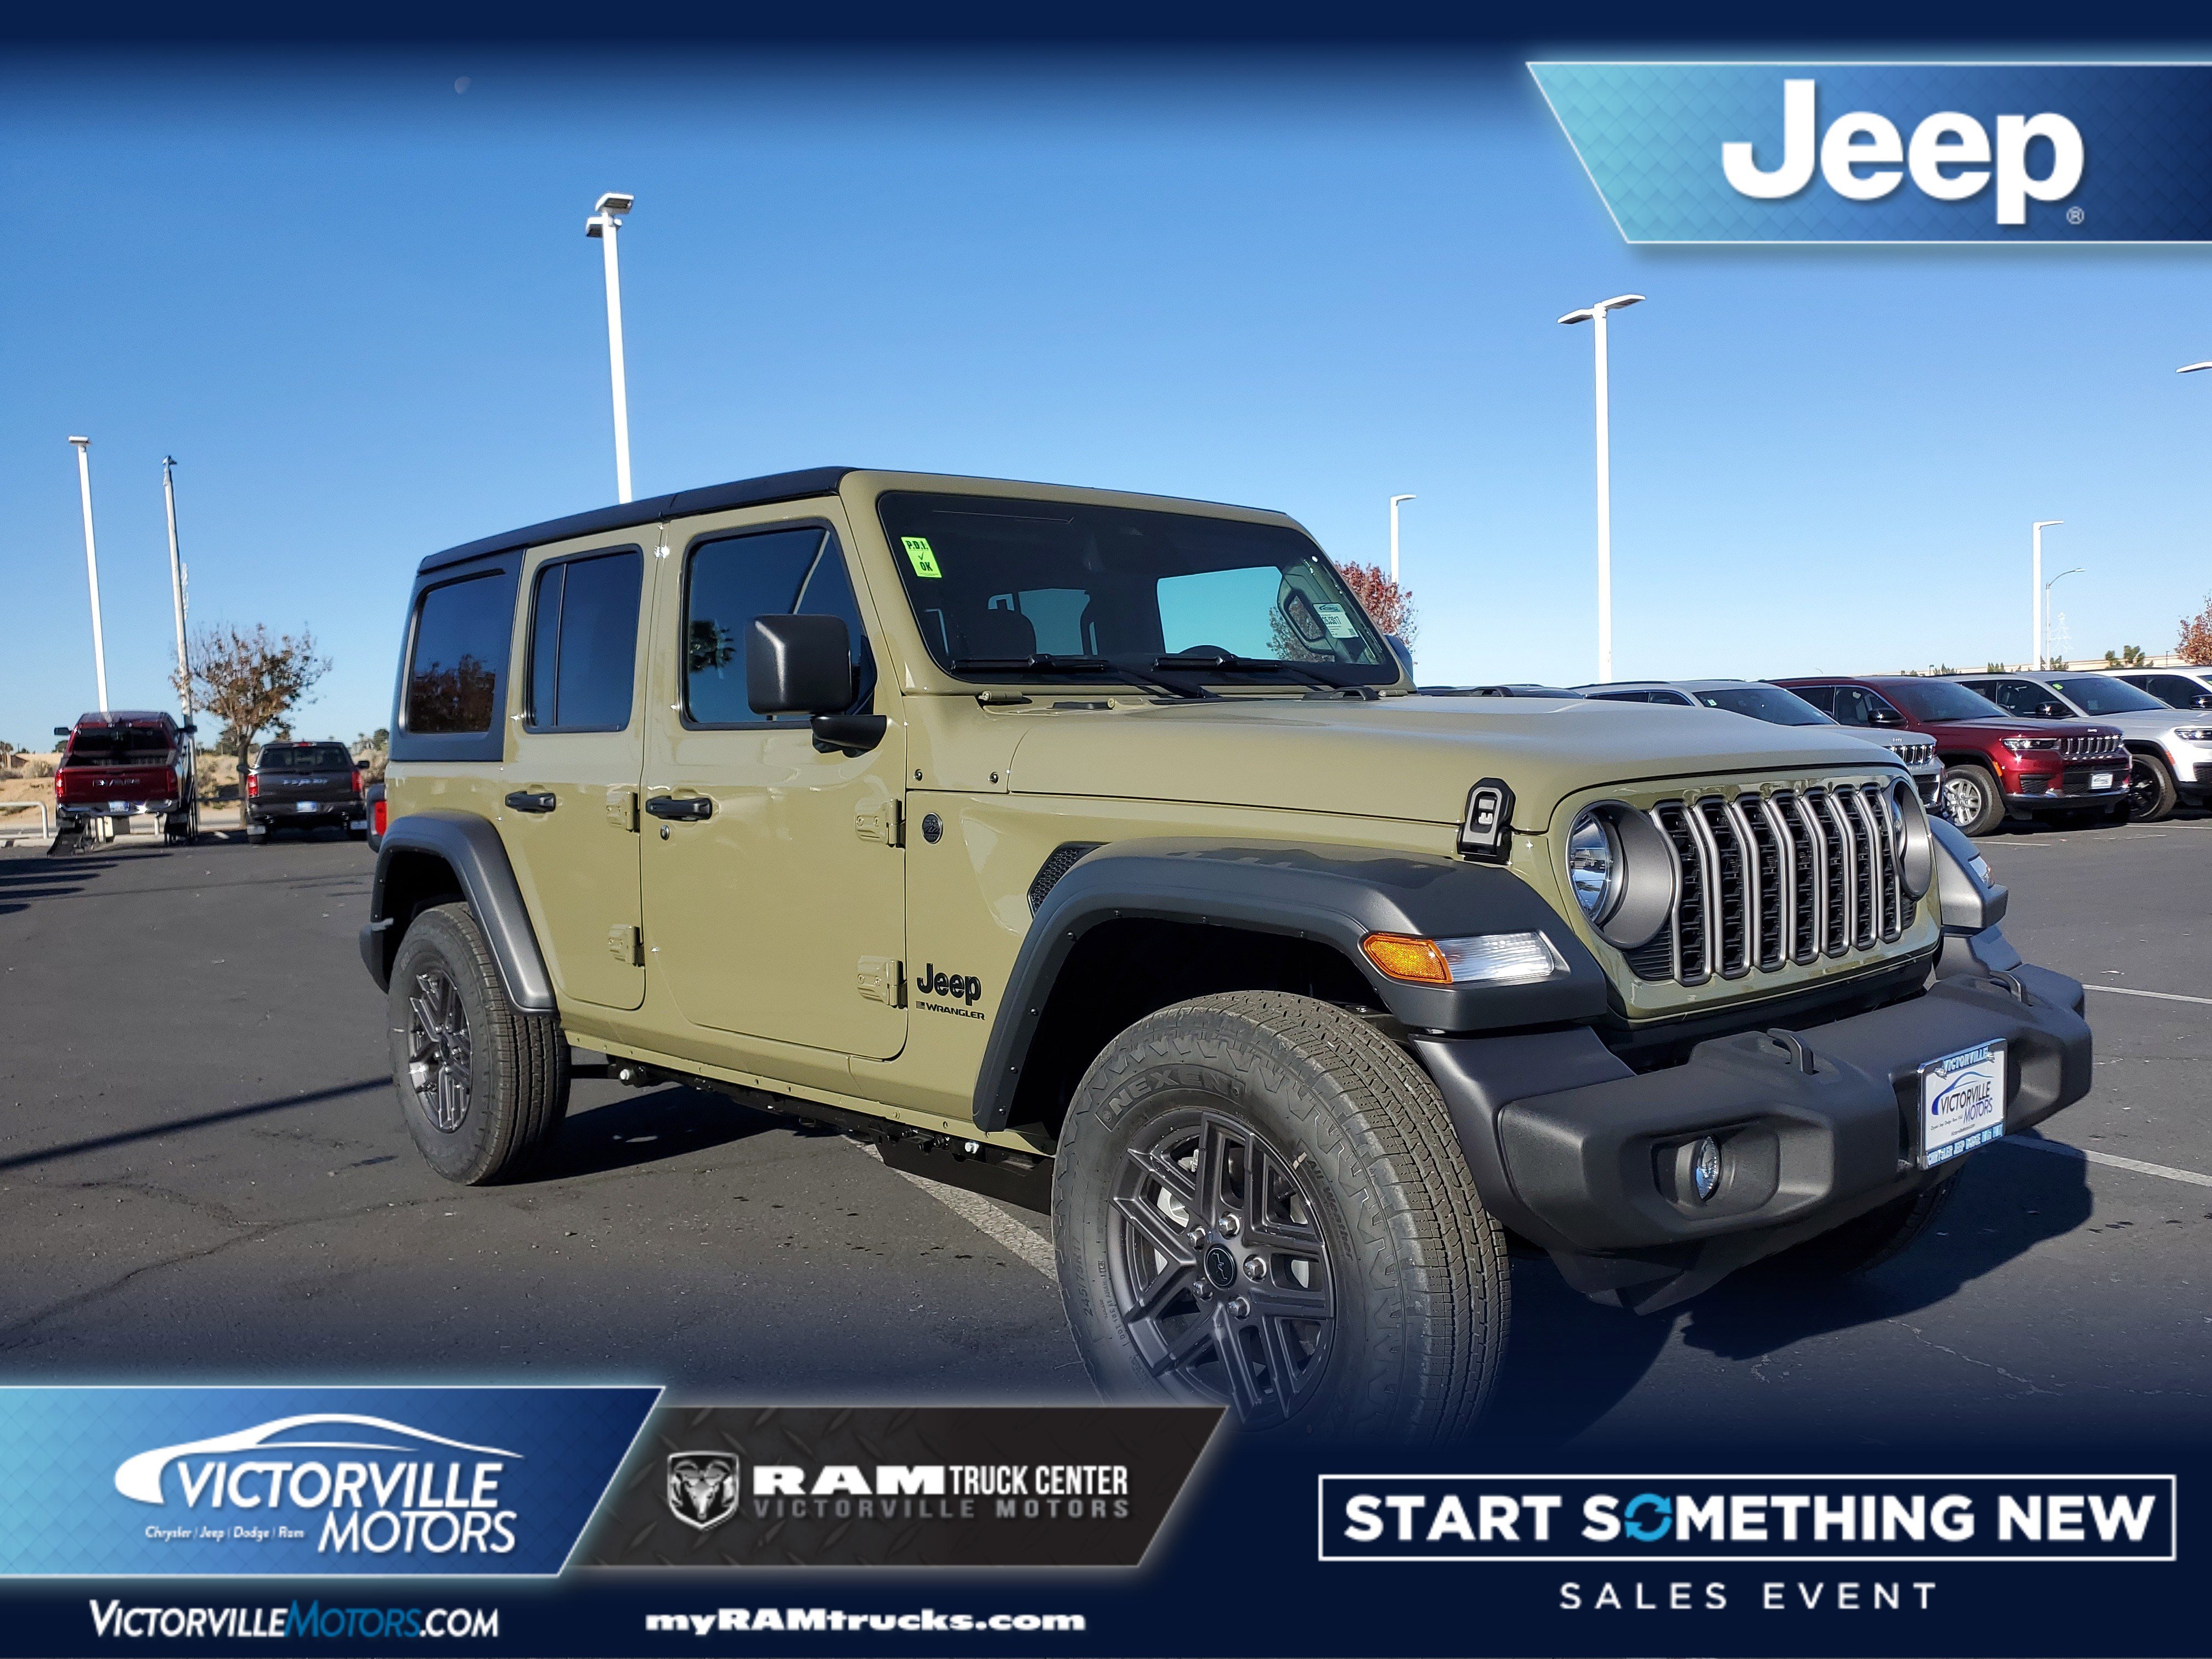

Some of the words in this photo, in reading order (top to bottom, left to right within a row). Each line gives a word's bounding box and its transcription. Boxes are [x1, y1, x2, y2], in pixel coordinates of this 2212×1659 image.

[905, 540, 929, 550] P.D.I.
[919, 562, 933, 571] OK
[917, 963, 981, 1006] Jeep
[926, 1002, 985, 1020] WRANGLER
[1108, 1069, 1232, 1116] NEXEN
[1941, 1081, 1991, 1115] VICTORVILLE
[1963, 1098, 1993, 1124] MOTORS
